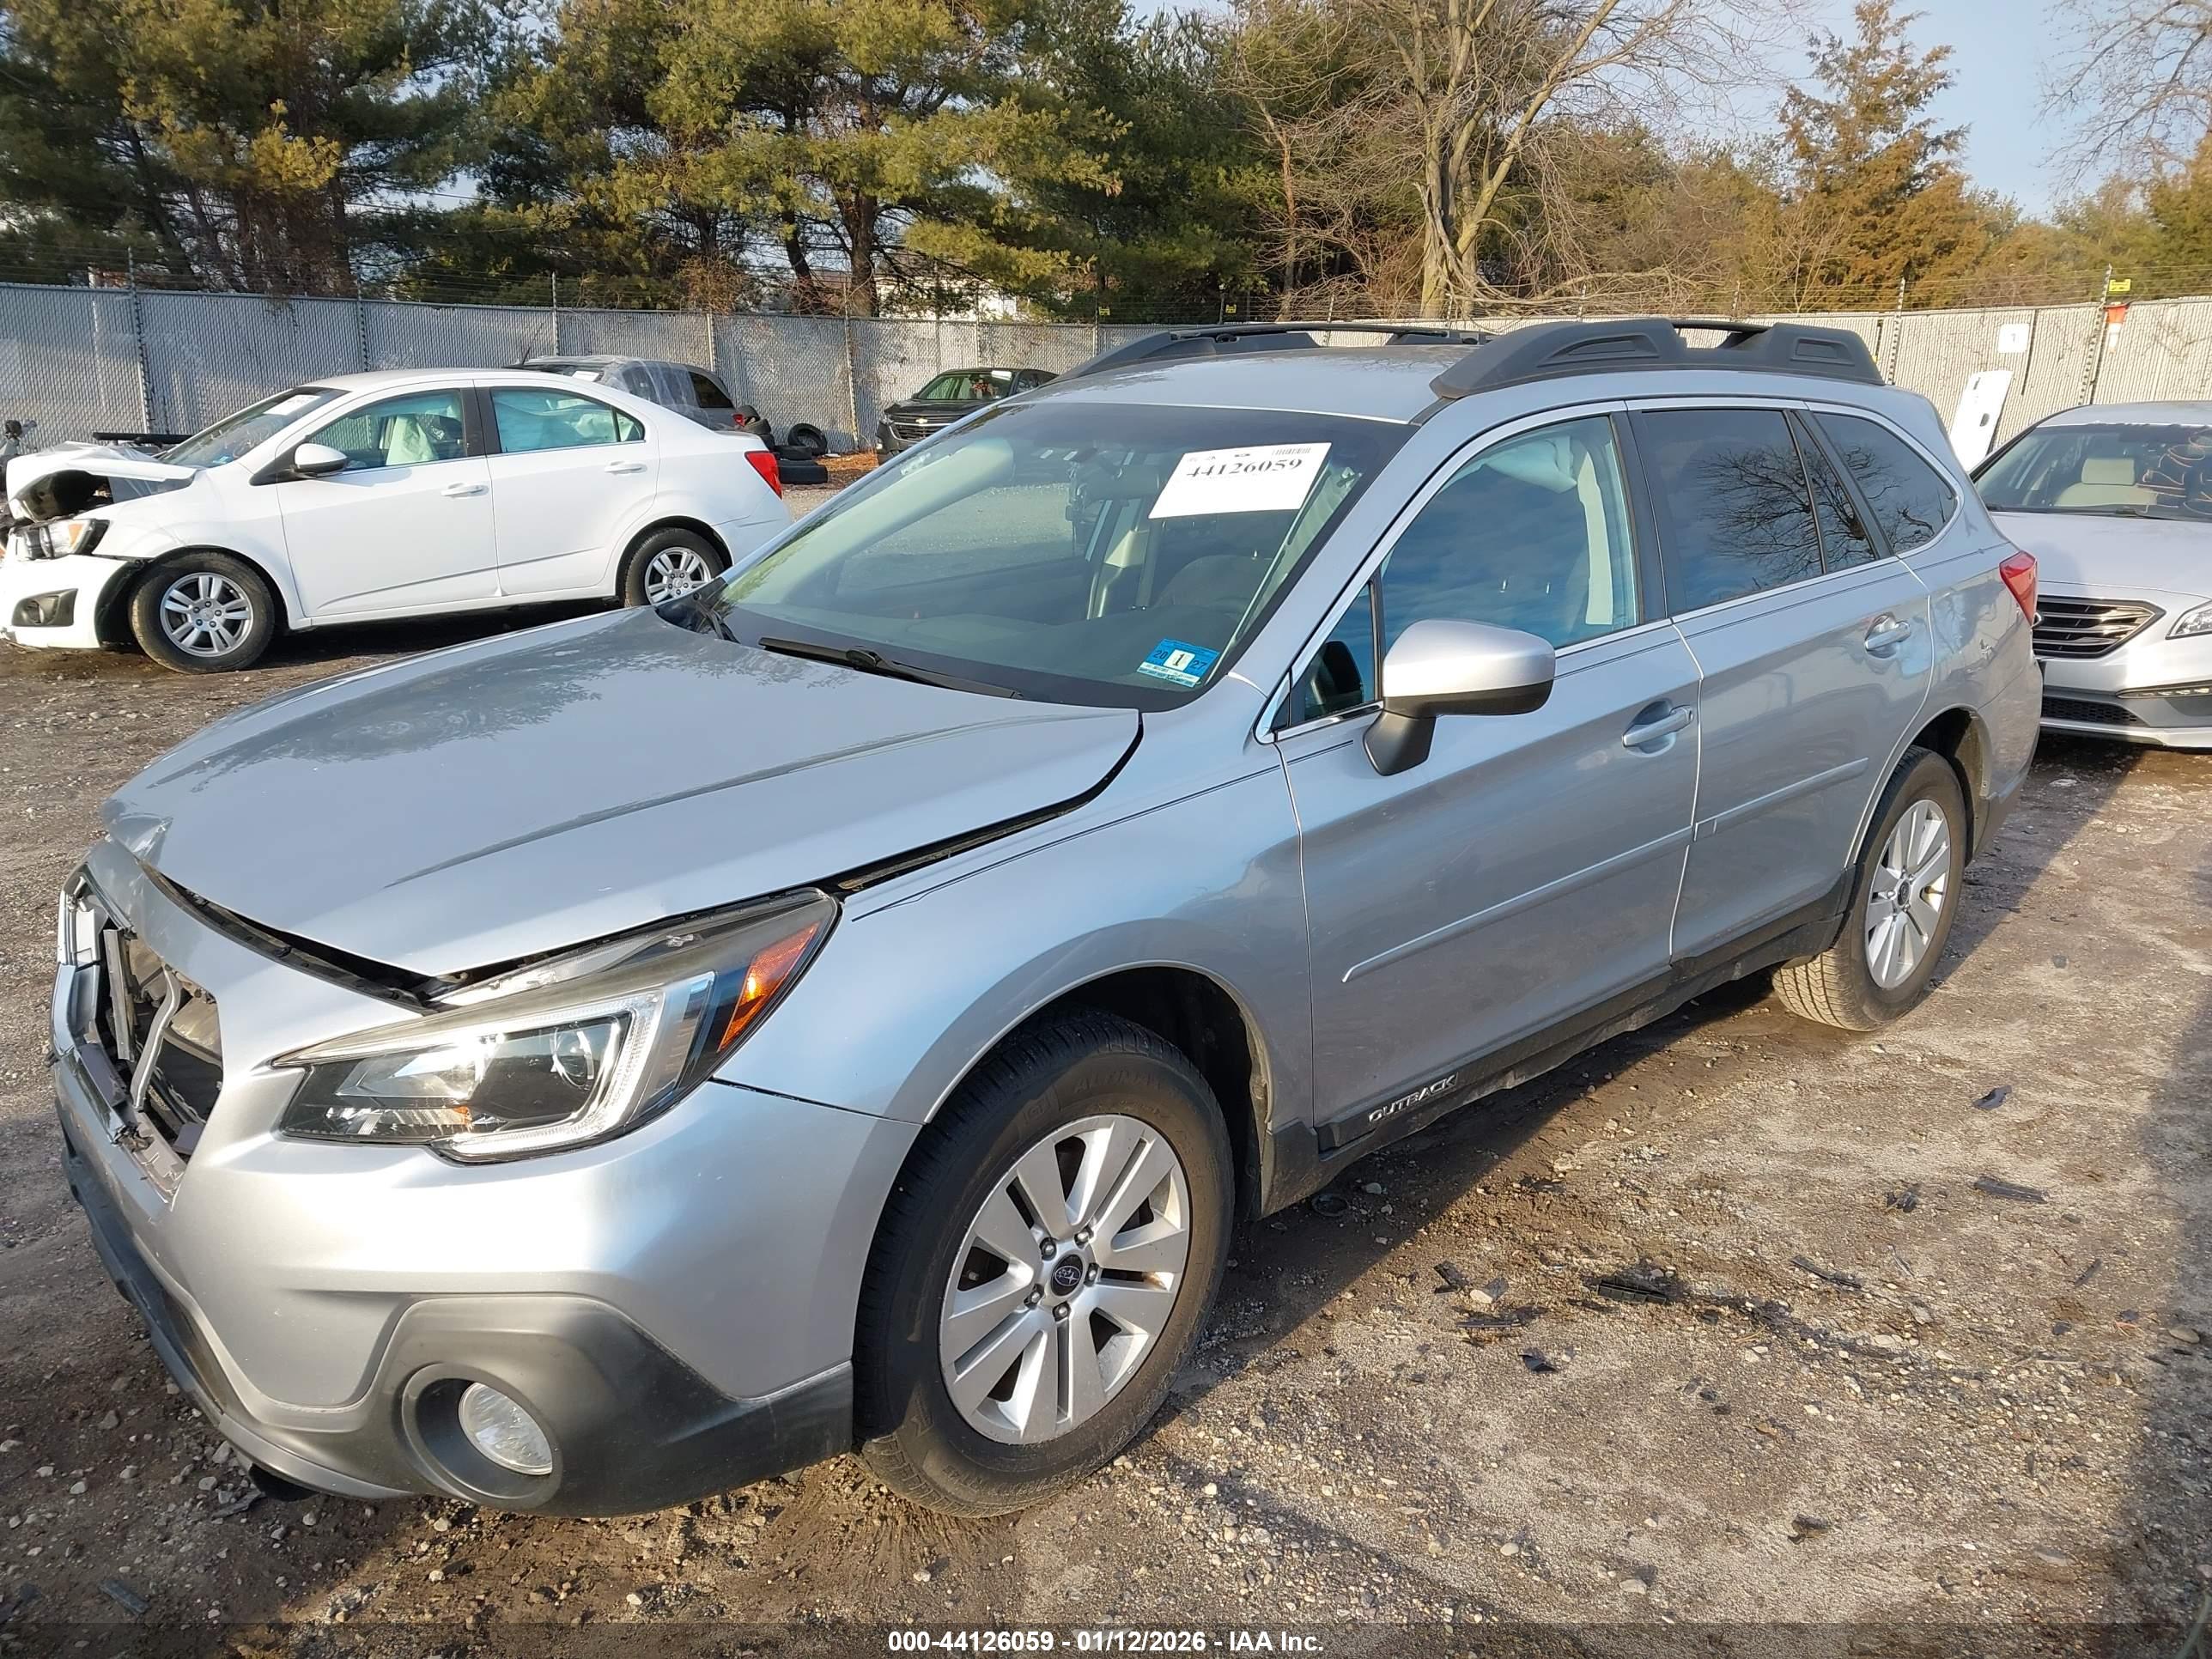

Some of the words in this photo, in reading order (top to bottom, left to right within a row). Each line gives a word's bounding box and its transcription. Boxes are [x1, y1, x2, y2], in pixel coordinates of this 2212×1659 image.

[1186, 458, 1304, 478] 44126059
[1172, 653, 1186, 667] 1
[1189, 659, 1207, 671] 27
[1368, 1074, 1457, 1122] OUTBACK
